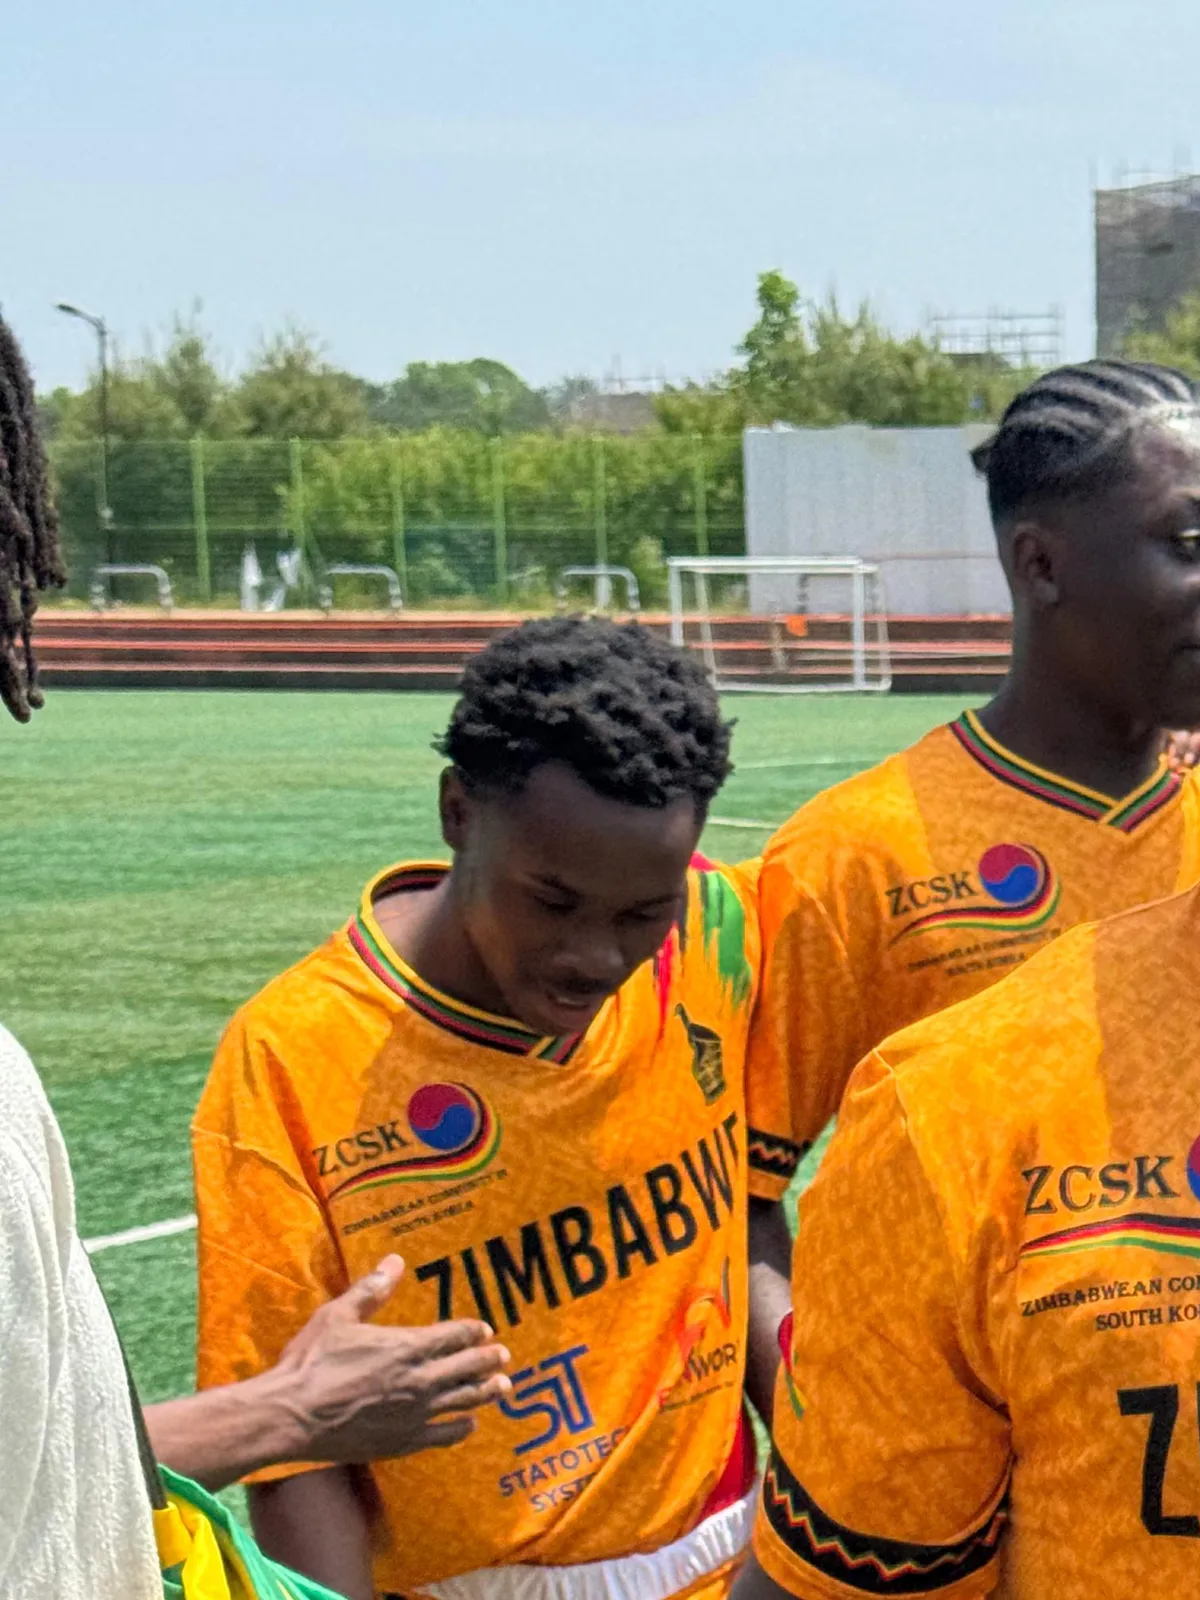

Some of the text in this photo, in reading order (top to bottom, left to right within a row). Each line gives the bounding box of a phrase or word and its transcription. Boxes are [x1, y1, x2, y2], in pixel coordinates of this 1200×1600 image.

[885, 871, 978, 918] ZCSK
[312, 1119, 409, 1176] ZCSK
[1021, 1155, 1182, 1216] ZCSK
[1021, 1278, 1162, 1317] ZIMBABWEAN
[1095, 1308, 1162, 1332] SOUTH
[498, 1425, 628, 1498] STATOTEC
